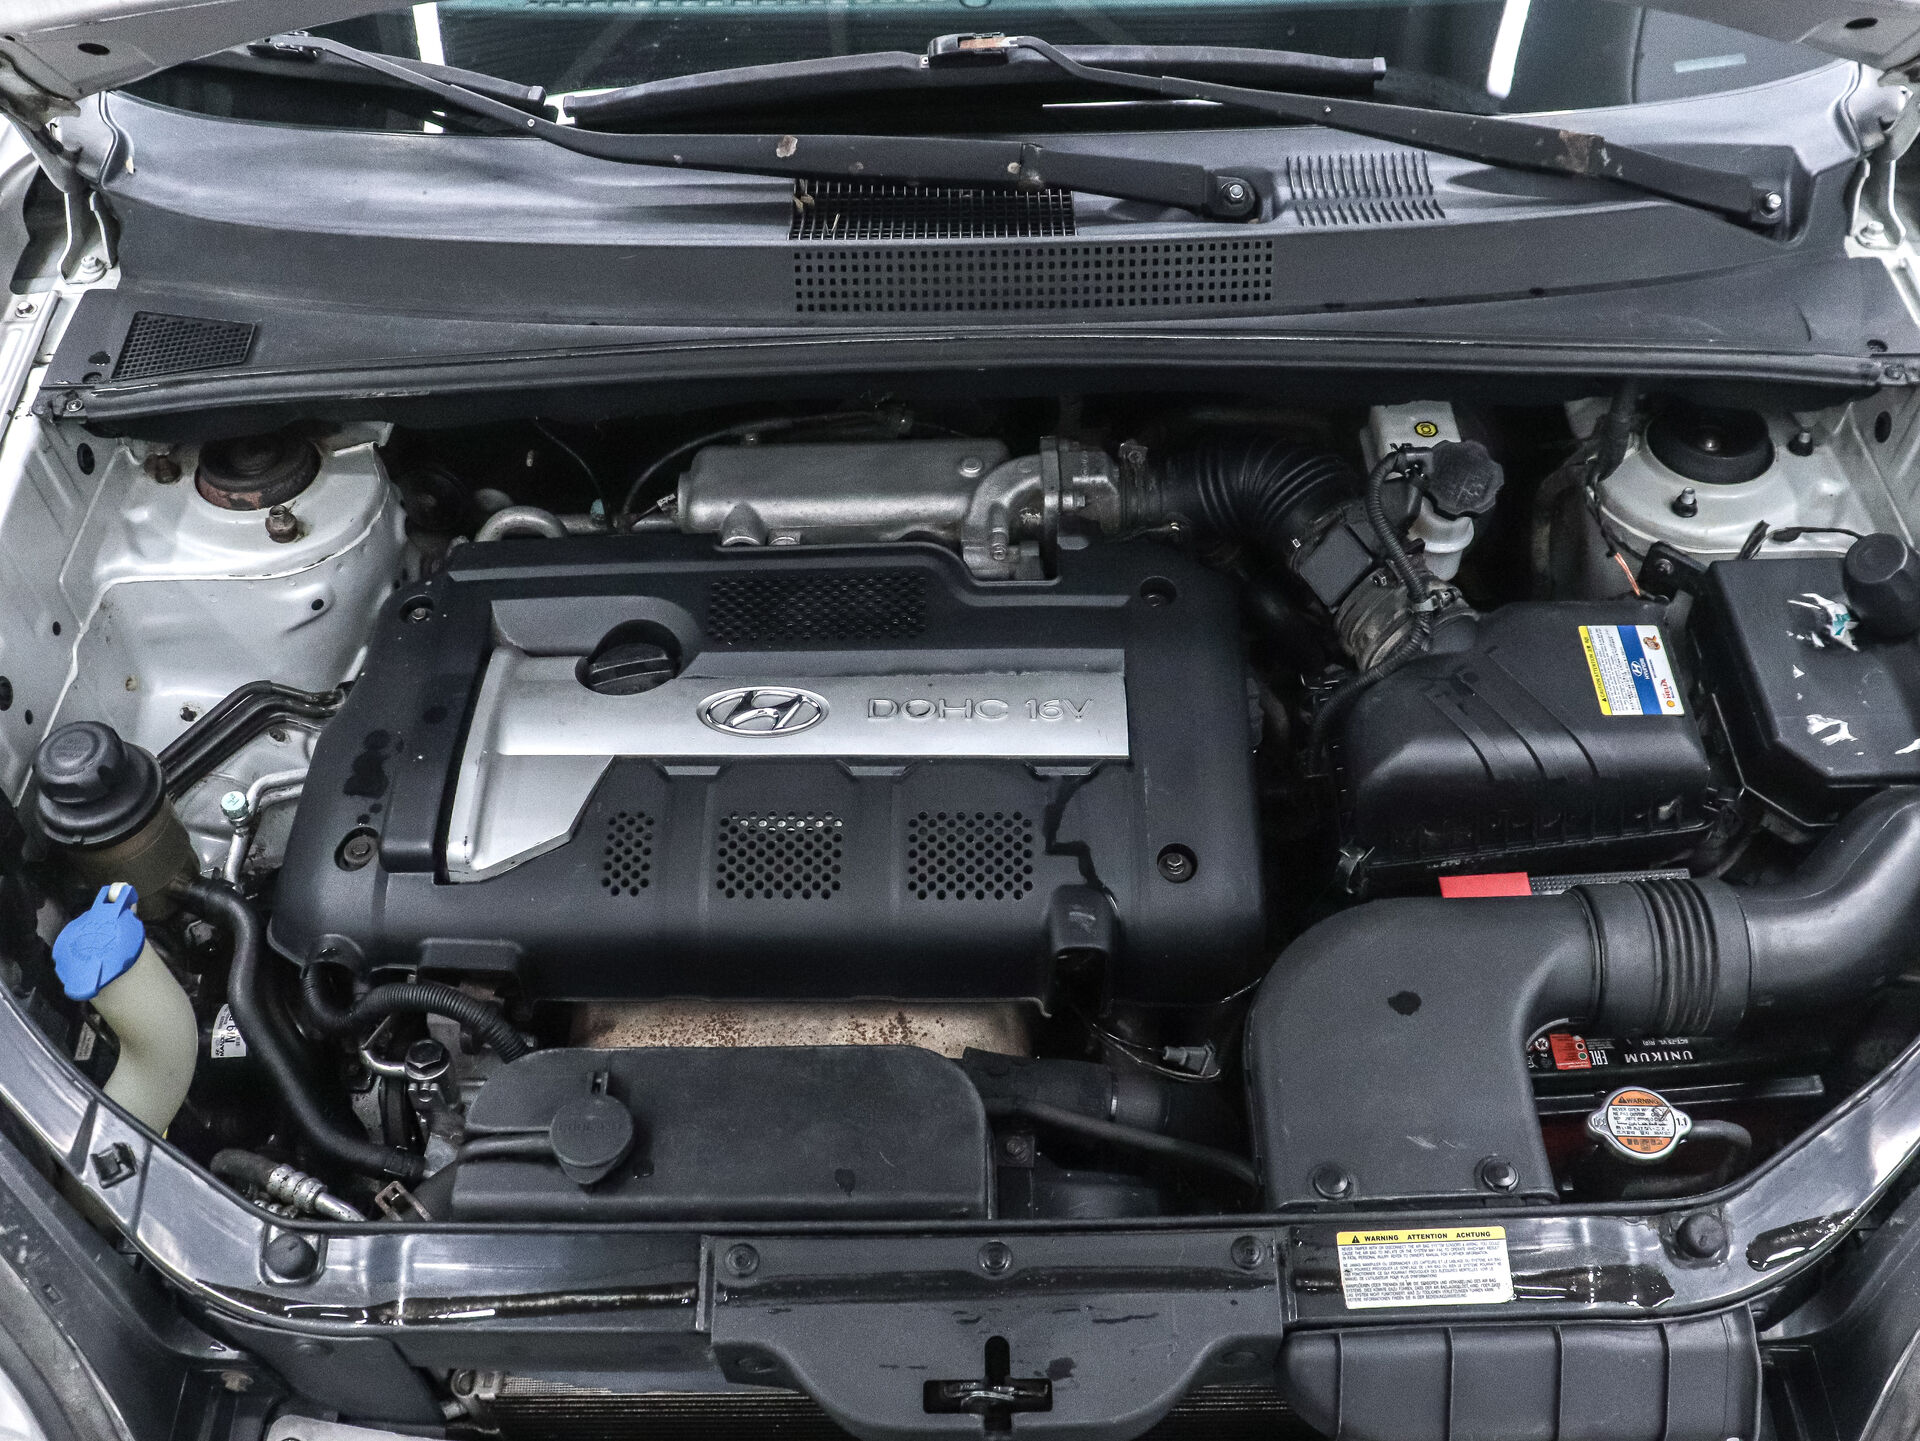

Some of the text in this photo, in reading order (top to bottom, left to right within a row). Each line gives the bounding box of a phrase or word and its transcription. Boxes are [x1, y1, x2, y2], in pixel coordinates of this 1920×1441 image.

[1596, 678, 1605, 697] CAUTION
[867, 699, 1093, 722] DOHC 16V
[1624, 1050, 1693, 1064] UNIKUM
[1676, 1117, 1688, 1126] 1.1
